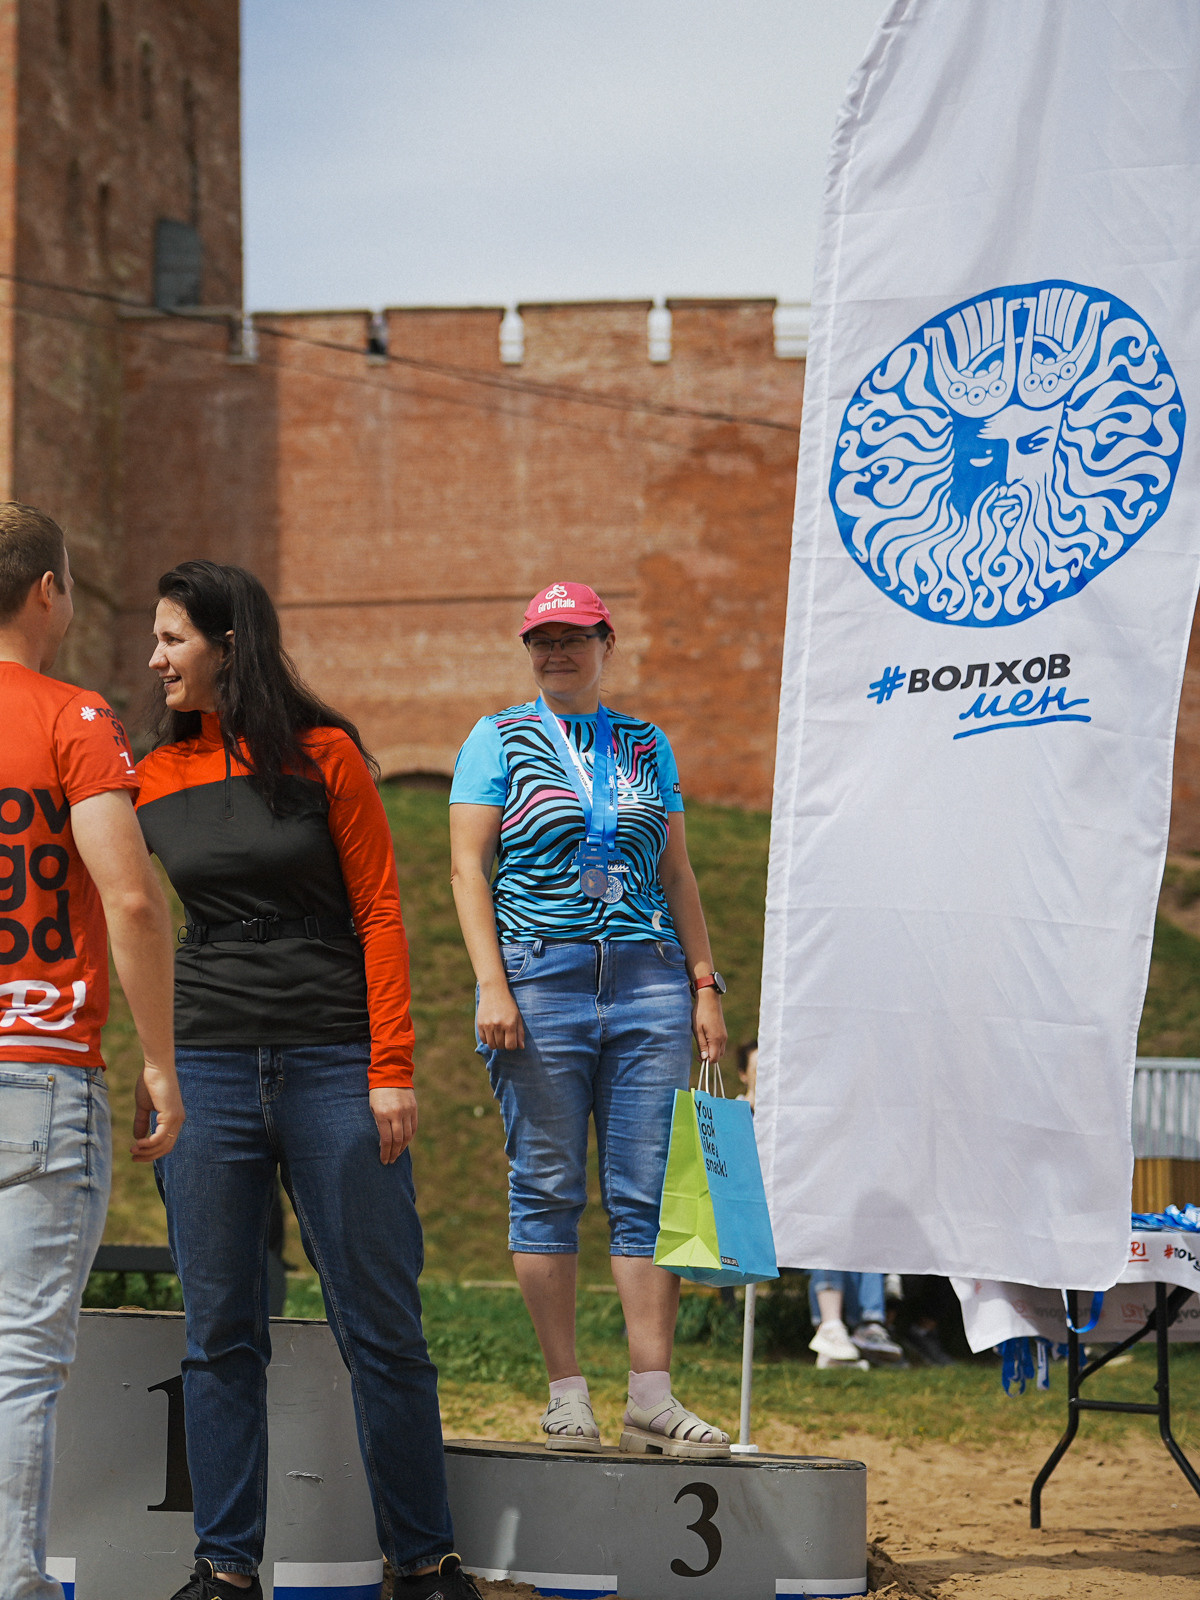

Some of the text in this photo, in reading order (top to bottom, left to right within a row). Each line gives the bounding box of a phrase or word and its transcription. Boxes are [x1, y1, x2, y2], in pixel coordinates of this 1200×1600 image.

[538, 602, 551, 614] Giro
[866, 653, 1071, 705] #ВОЛХОВ
[958, 686, 1090, 720] мен
[694, 1100, 714, 1121] You
[705, 1158, 728, 1178] snack!
[147, 1374, 195, 1513] 1
[671, 1481, 723, 1578] 3
